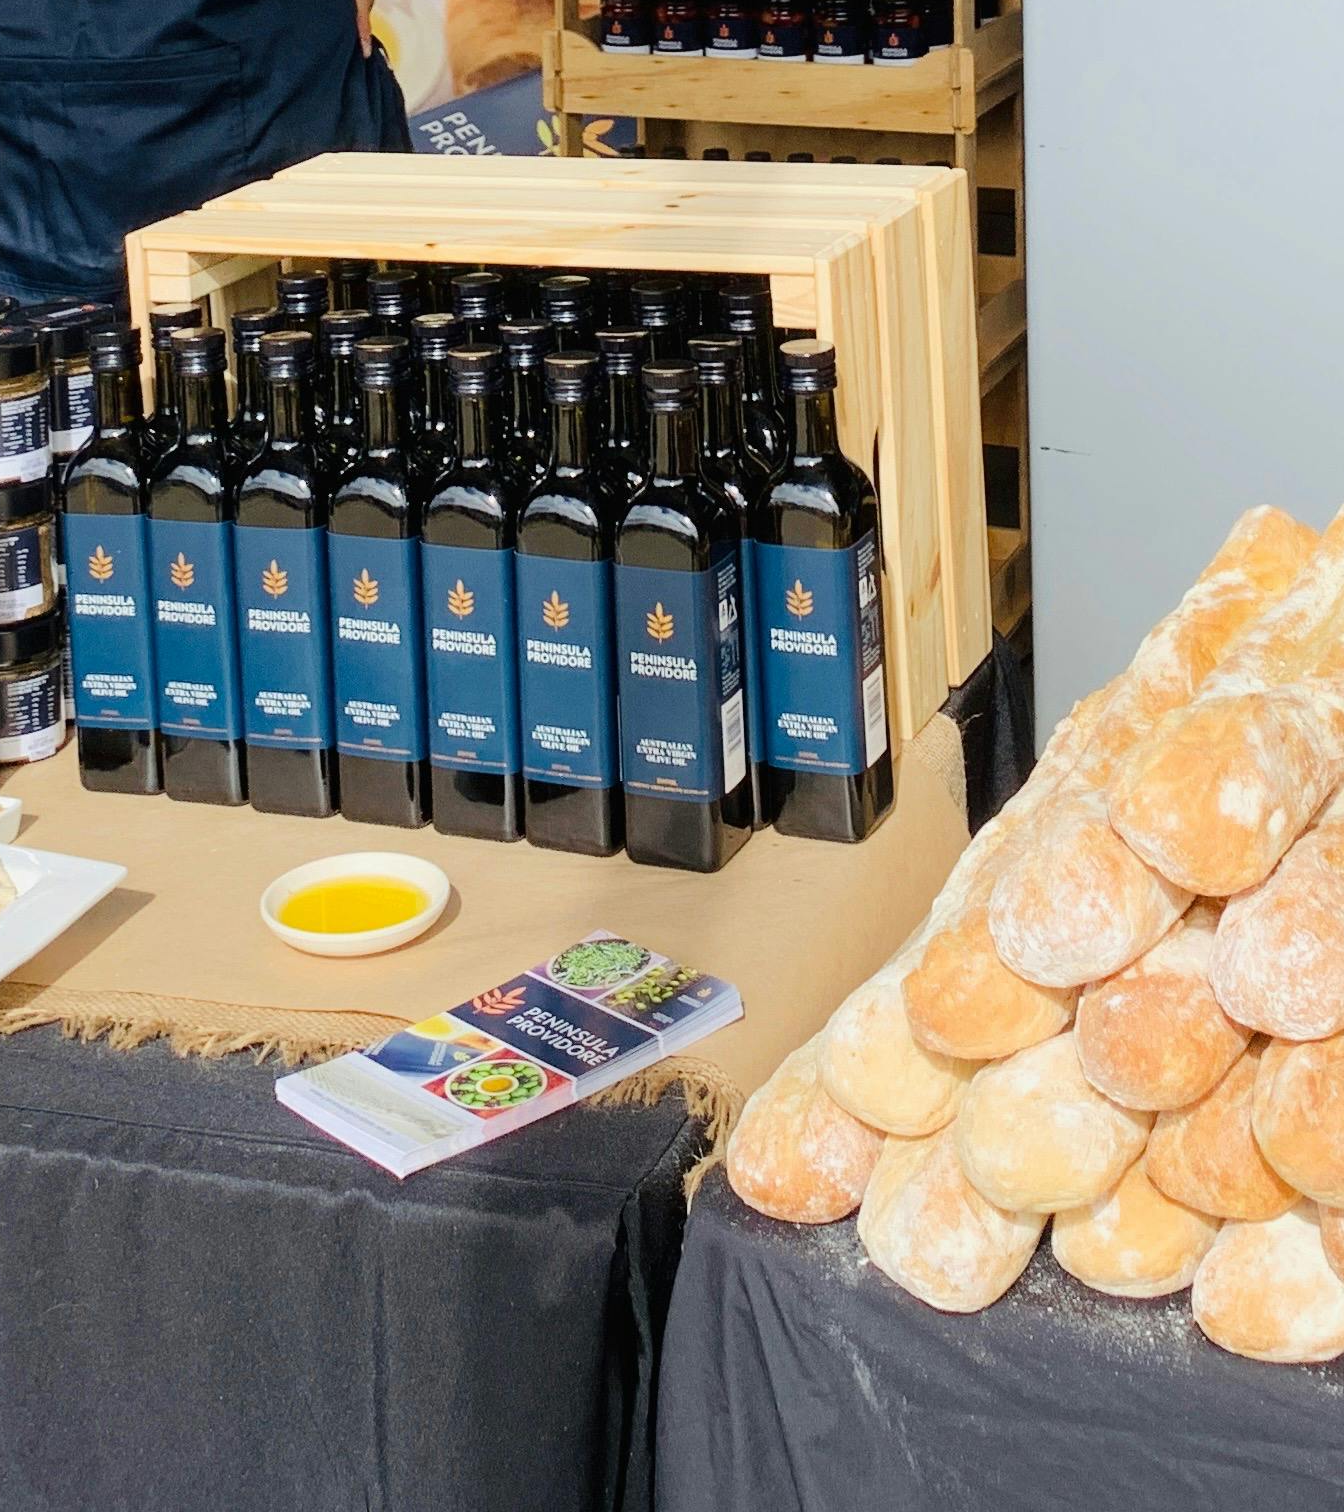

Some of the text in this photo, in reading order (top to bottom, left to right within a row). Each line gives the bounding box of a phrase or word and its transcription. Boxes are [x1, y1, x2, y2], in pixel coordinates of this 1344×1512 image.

[75, 594, 135, 606] PENINSULA
[158, 600, 215, 614] PENINSULA
[75, 604, 136, 617] PROVIDORE
[158, 611, 216, 626] PROVIDORE
[248, 609, 310, 623] PENINSULA
[248, 620, 311, 633] PROVIDORE
[339, 617, 400, 633] PENINSULA
[339, 628, 400, 645] PROVIDORE
[432, 628, 495, 645] PENINSULA
[770, 628, 836, 645] PENINSULA
[432, 639, 496, 656] PROVIDORE
[527, 640, 591, 657] PENINSULA
[771, 639, 838, 656] PROVIDORE
[527, 651, 592, 668] PROVIDORE
[630, 652, 697, 669] PENINSULA
[630, 664, 698, 681] PROVIDORE
[506, 1015, 608, 1065] PROVIDORE
[523, 1007, 619, 1058] PENINSULA
